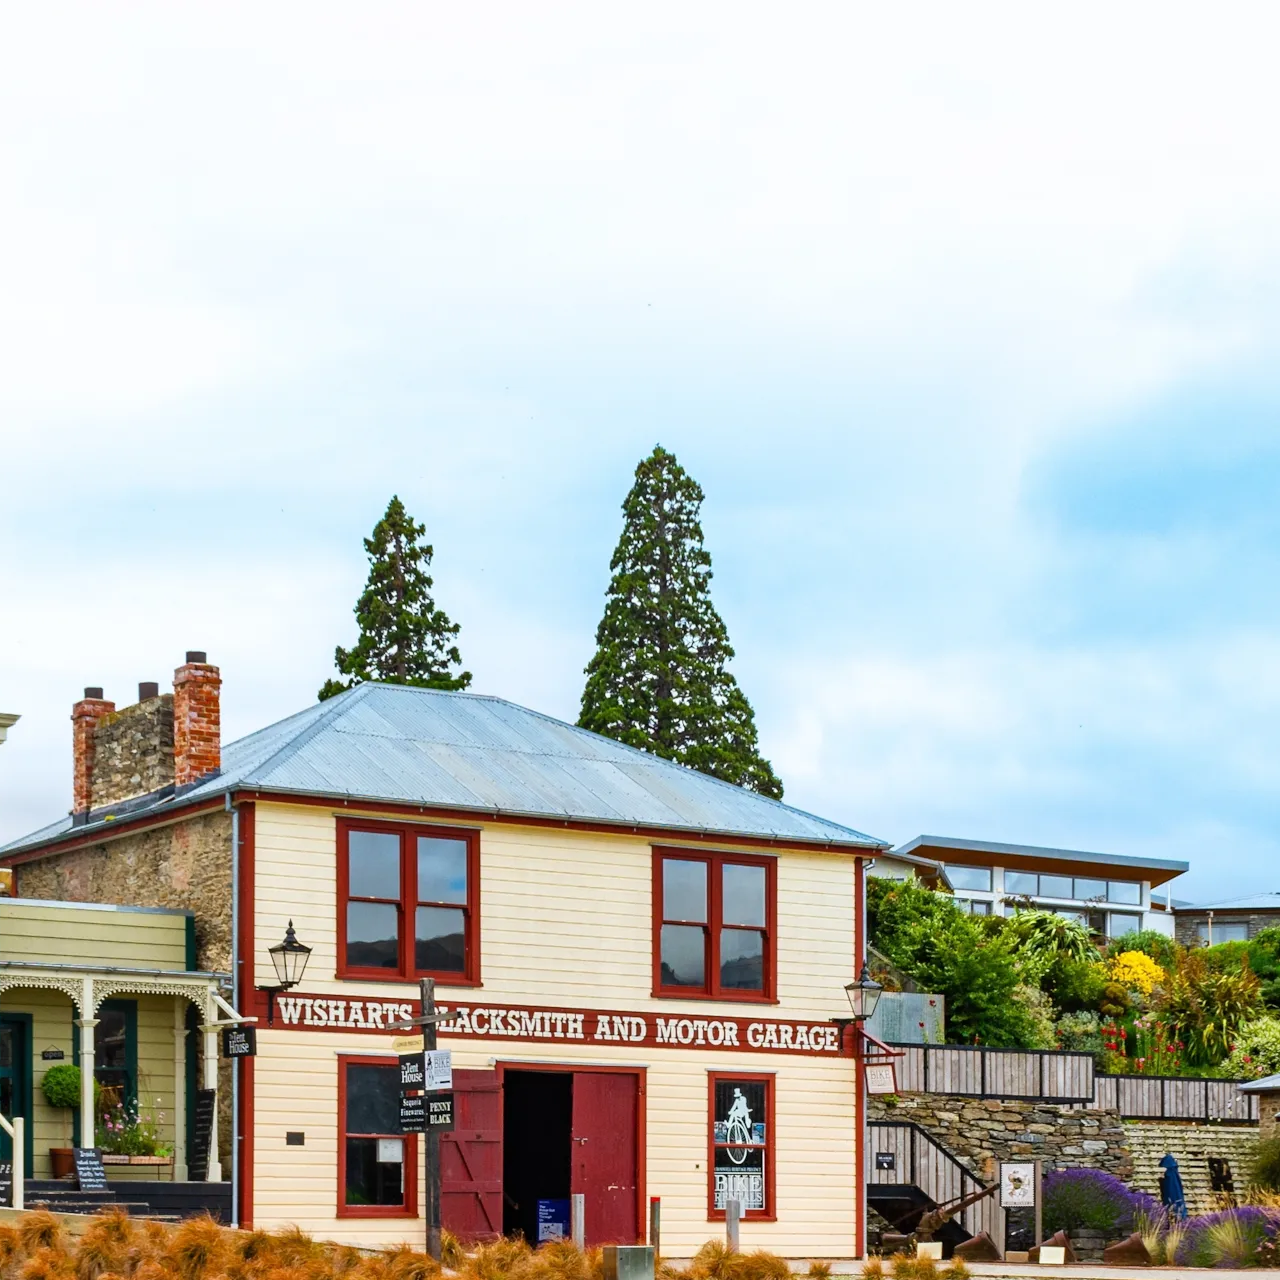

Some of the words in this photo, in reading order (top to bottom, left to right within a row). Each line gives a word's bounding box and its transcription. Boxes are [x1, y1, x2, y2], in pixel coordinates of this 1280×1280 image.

[277, 997, 413, 1031] WISHARTS
[434, 1006, 584, 1039] LACKSMITH
[594, 1015, 646, 1042] AND
[656, 1018, 740, 1046] MOTOR
[747, 1023, 838, 1051] GARAGE
[229, 1041, 250, 1054] House
[406, 1063, 418, 1073] Tent
[434, 1057, 450, 1069] BIKE
[401, 1071, 423, 1083] House
[871, 1069, 891, 1080] BIKE
[403, 1098, 422, 1107] Sequoia
[429, 1102, 451, 1112] PENNY
[430, 1114, 451, 1124] BLACK
[714, 1174, 762, 1191] BIKE
[714, 1192, 763, 1202] RENTALS
